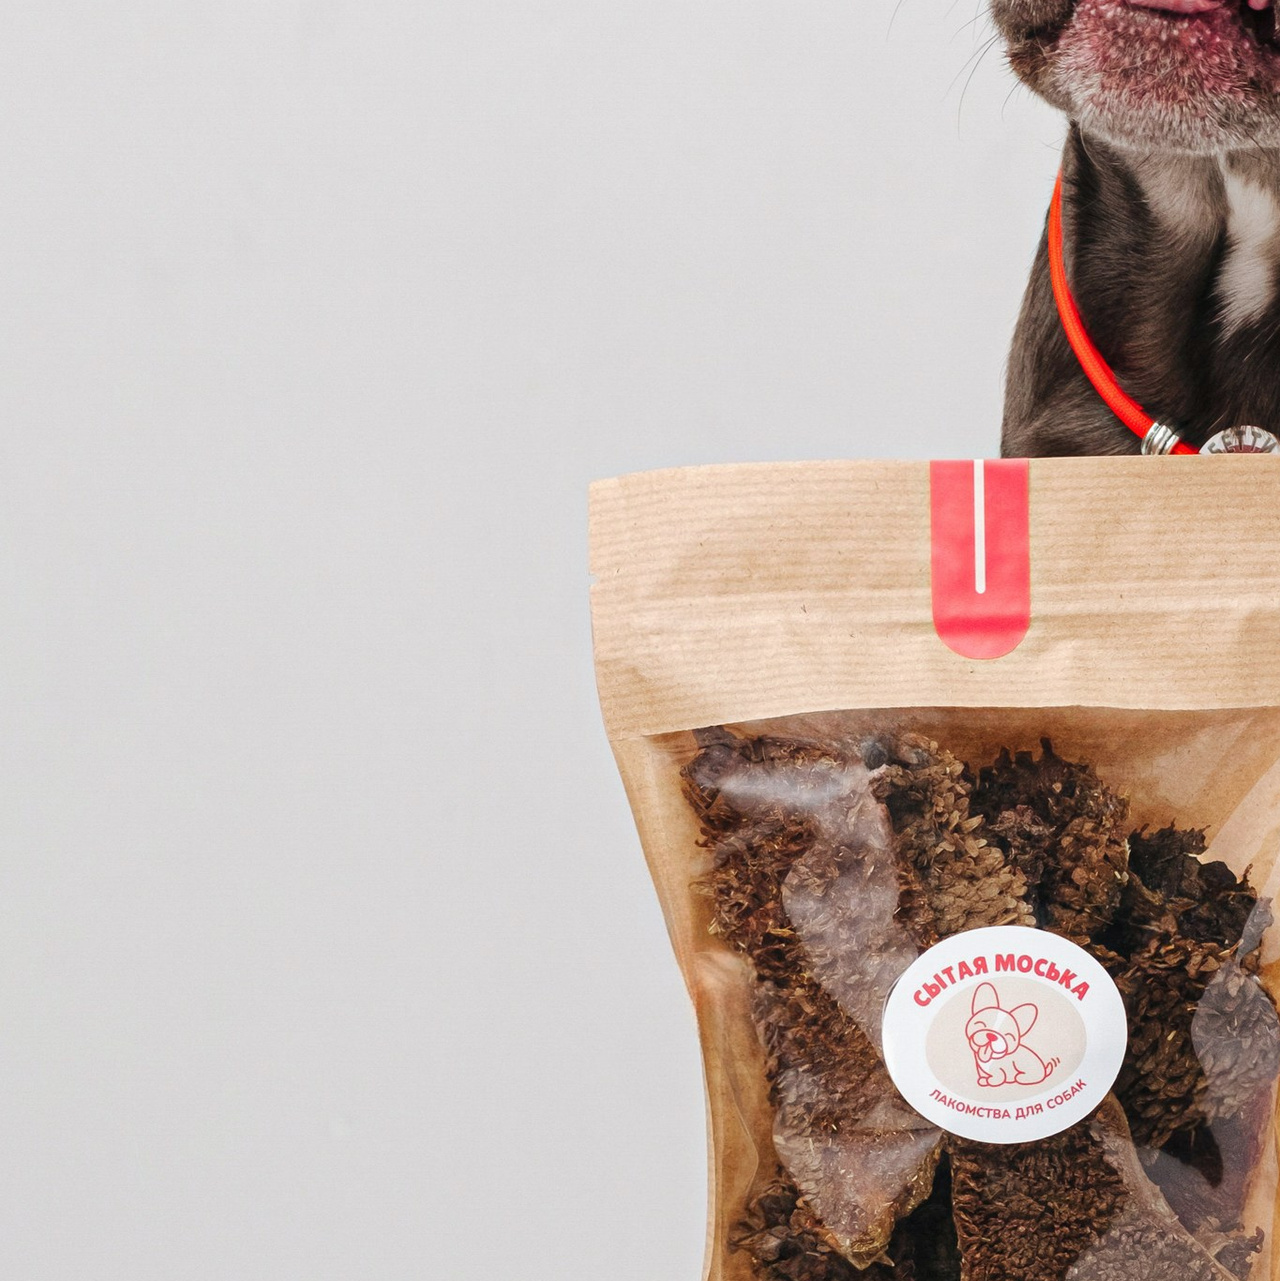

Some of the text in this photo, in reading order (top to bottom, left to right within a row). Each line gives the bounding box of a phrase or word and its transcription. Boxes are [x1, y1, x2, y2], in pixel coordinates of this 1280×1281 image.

[913, 953, 1090, 1007] СЫТАЯ МОСЬКА
[928, 1078, 1087, 1120] ЛАКОМСТВА ДЛЯ СОБАК
